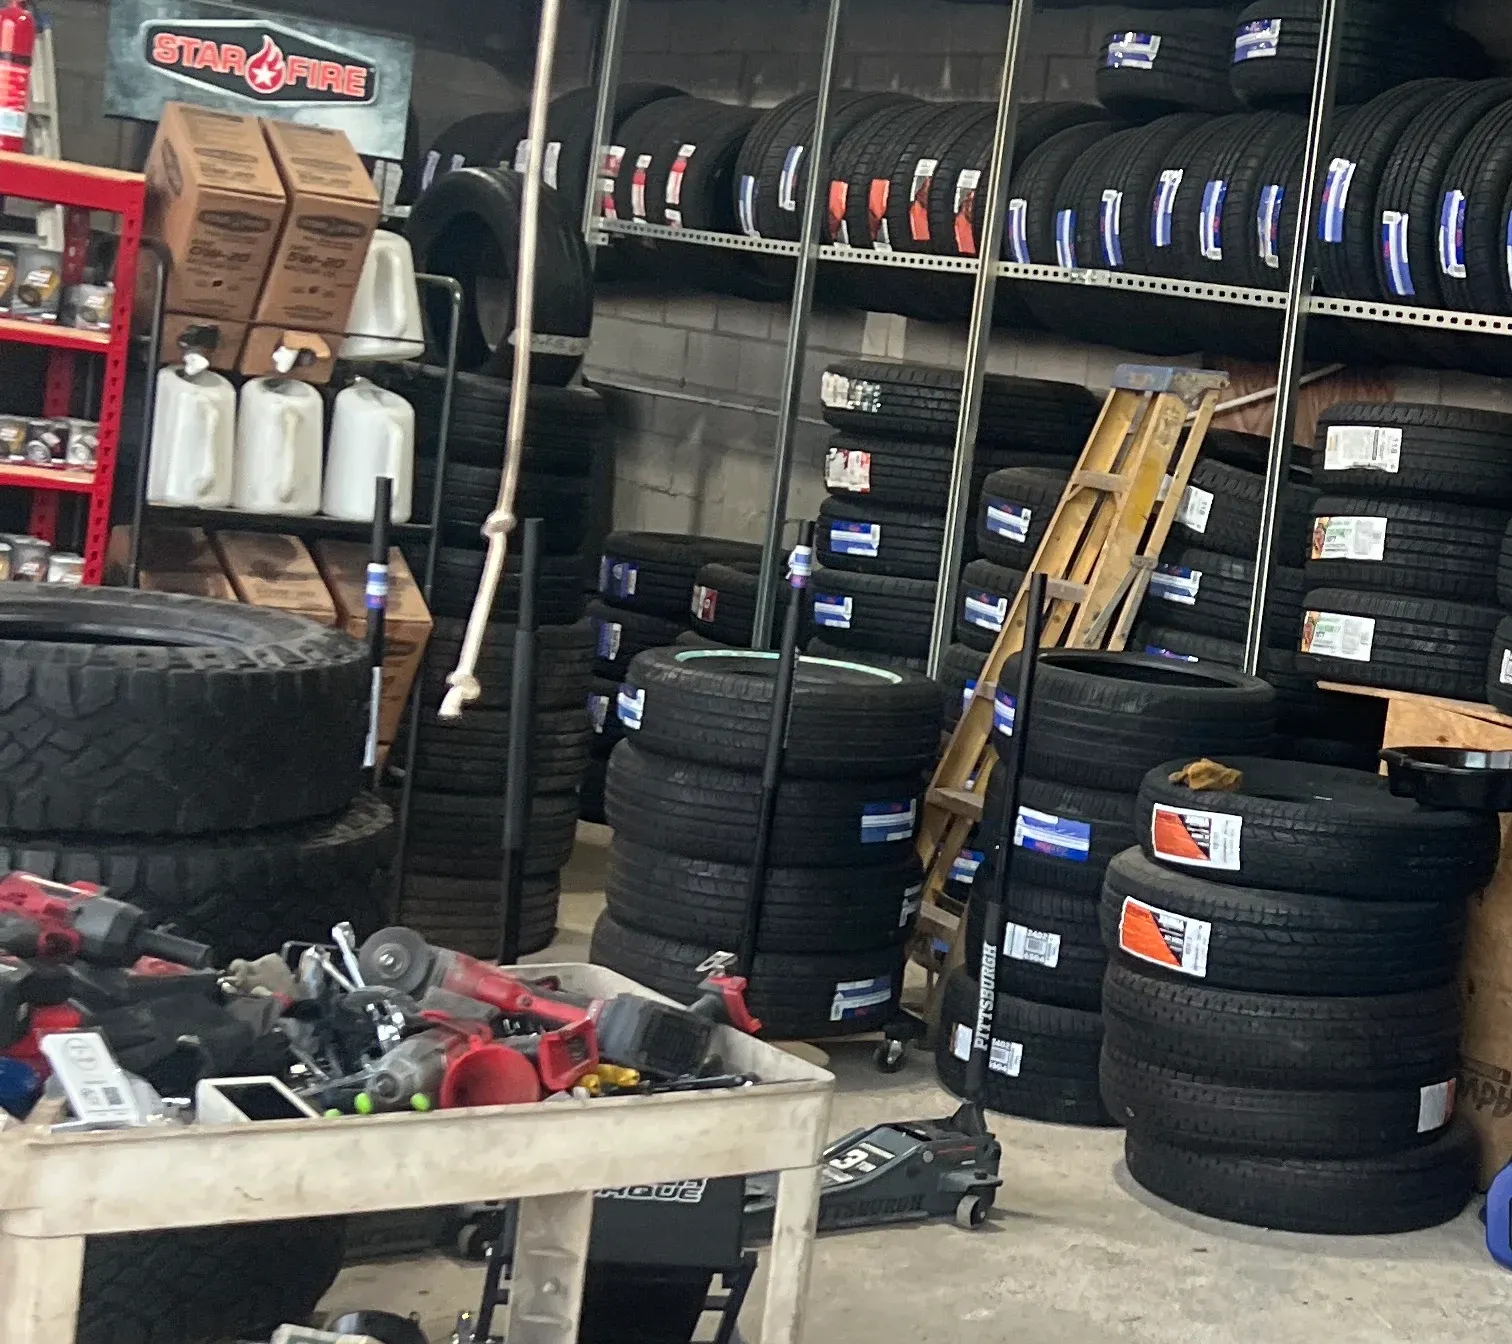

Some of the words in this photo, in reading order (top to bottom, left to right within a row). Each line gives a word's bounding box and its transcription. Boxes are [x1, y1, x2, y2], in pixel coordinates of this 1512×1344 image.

[152, 32, 247, 77] STAR
[286, 55, 367, 98] FIRE
[973, 939, 997, 1052] PITTSBURGH
